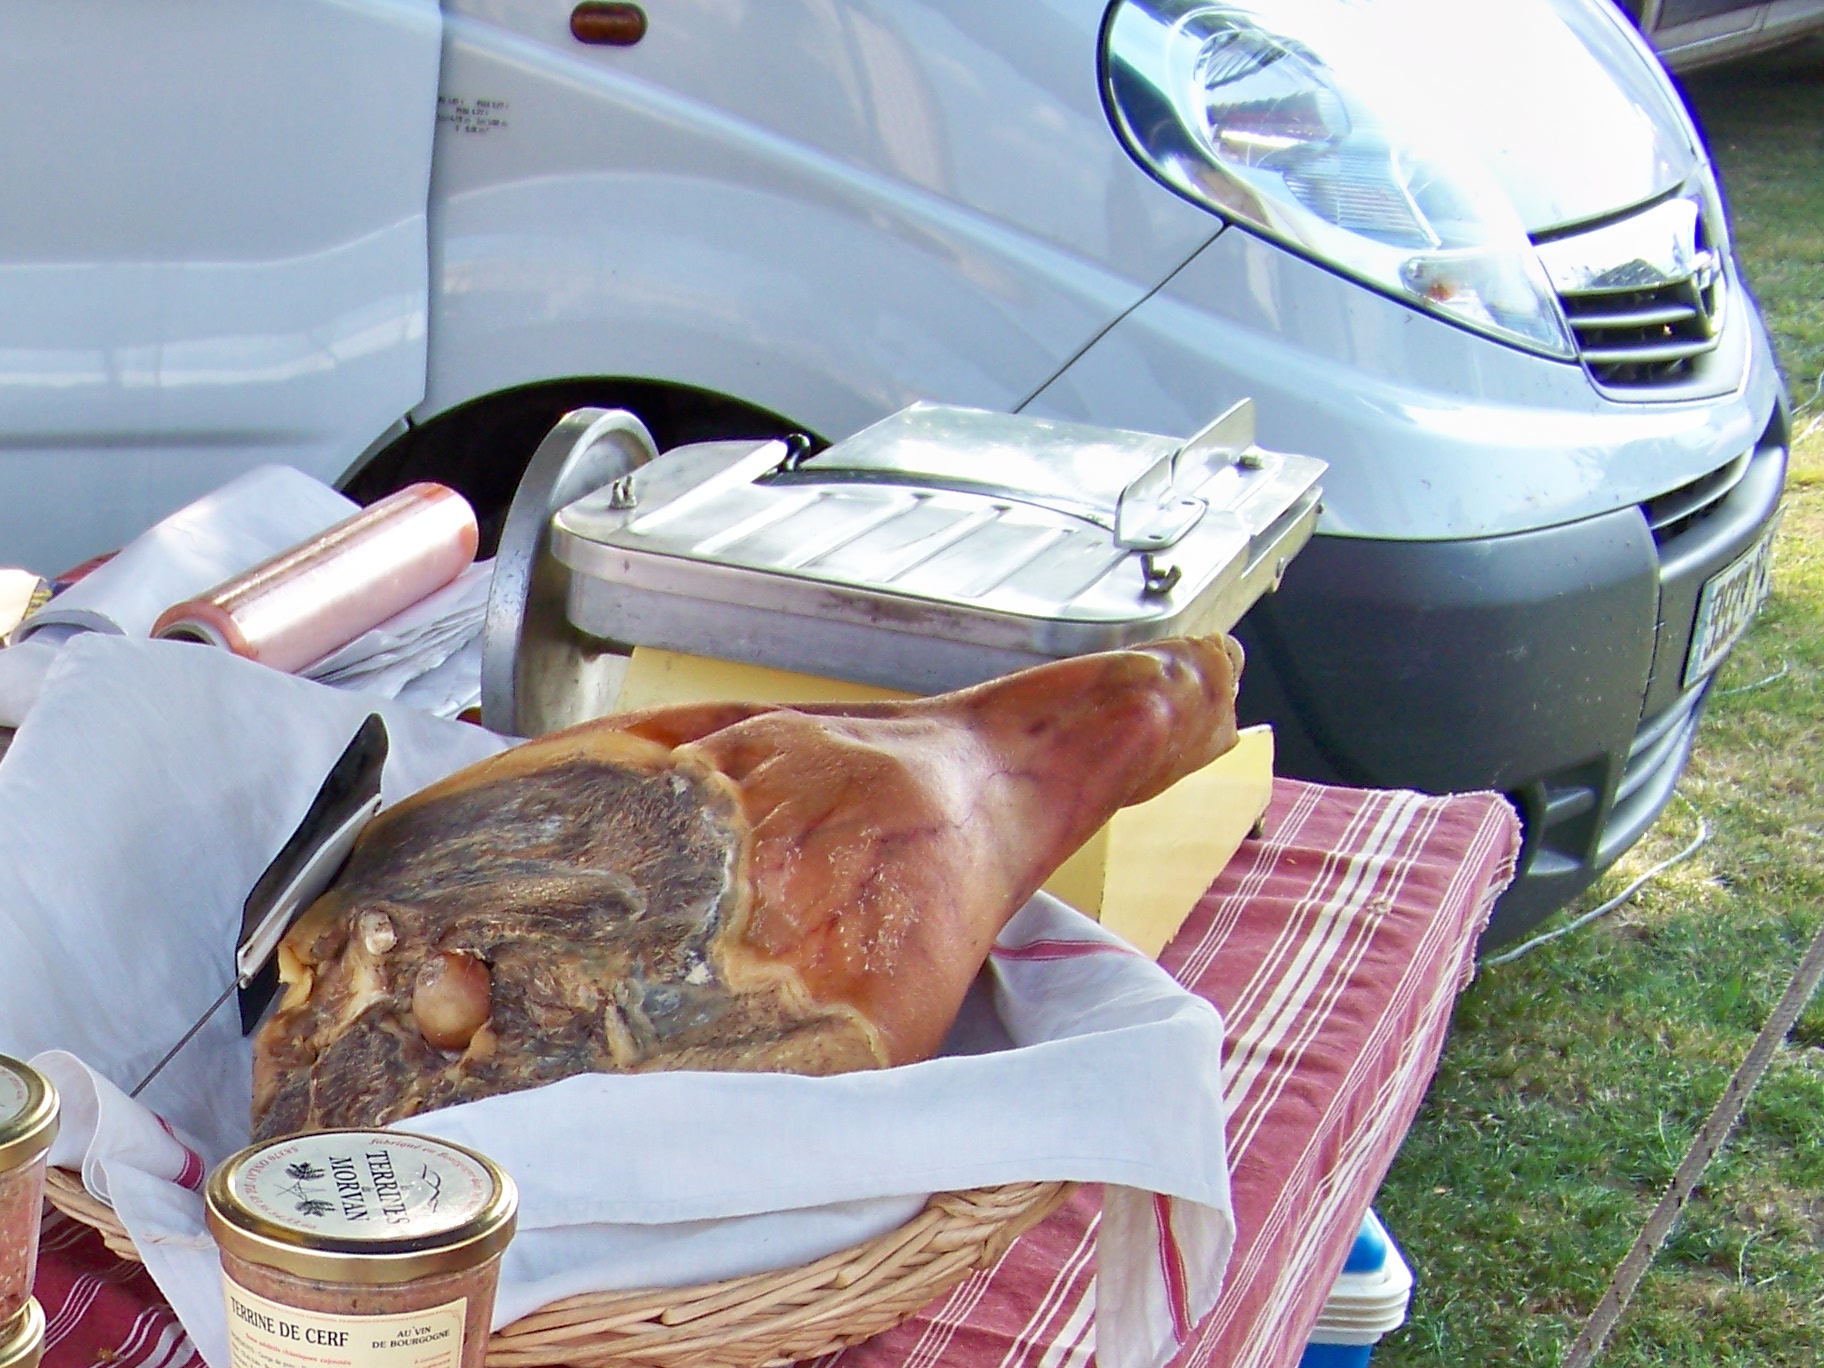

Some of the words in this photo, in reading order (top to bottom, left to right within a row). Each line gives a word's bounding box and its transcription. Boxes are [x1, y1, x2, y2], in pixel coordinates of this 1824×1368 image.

[329, 1155, 370, 1222] MORVAN
[230, 1296, 276, 1335] TERRINE
[279, 1321, 301, 1342] DE
[305, 1328, 350, 1348] CERF
[390, 1328, 450, 1348] BOURGOGNE
[397, 1329, 412, 1338] AU
[414, 1325, 432, 1335] VIN
